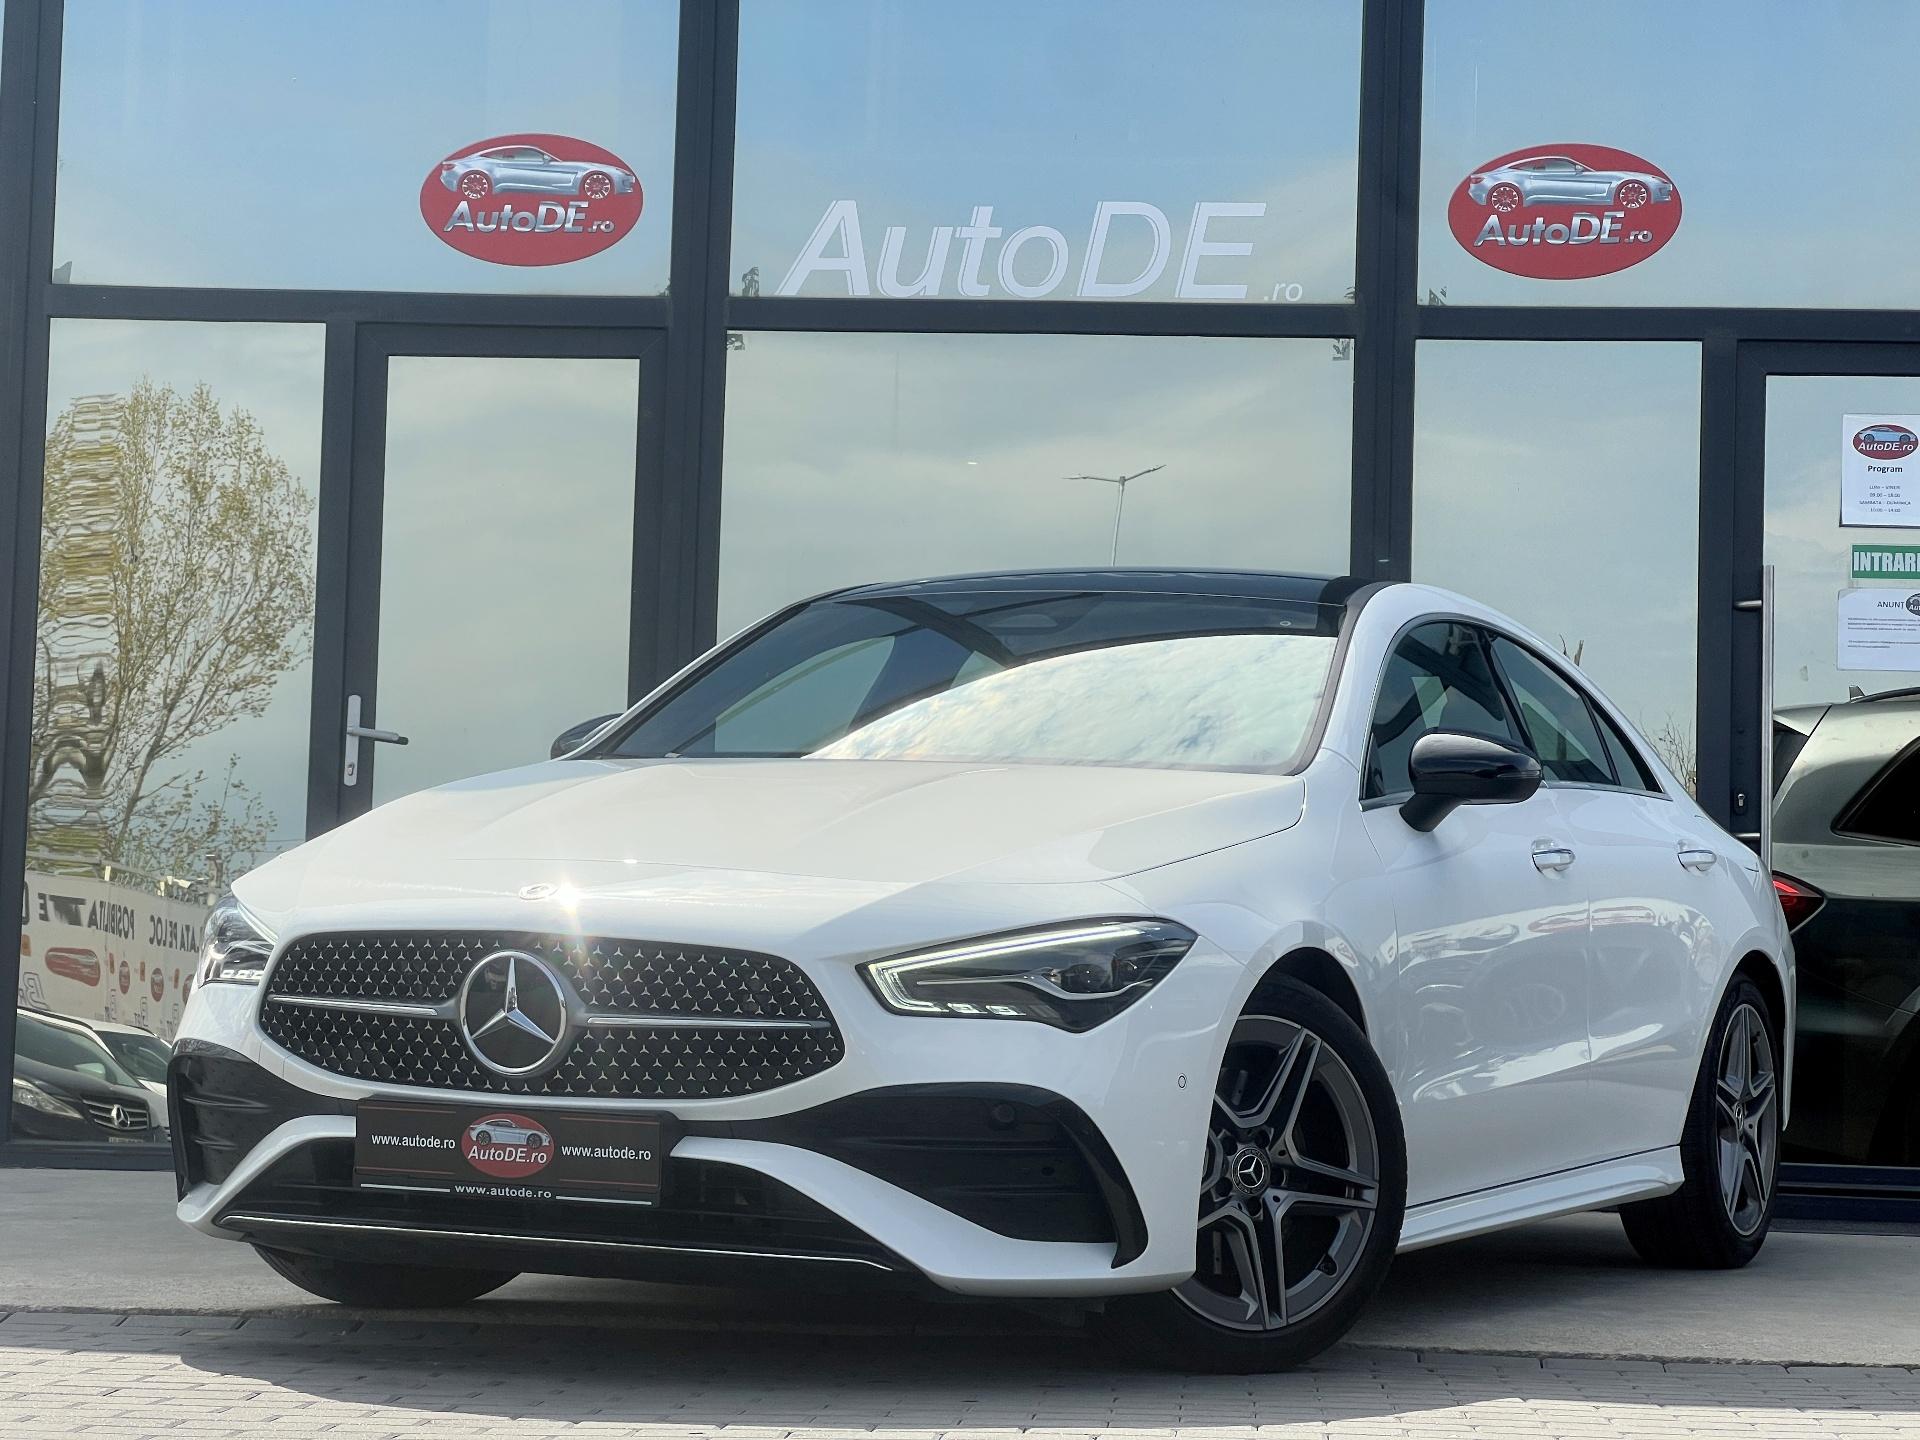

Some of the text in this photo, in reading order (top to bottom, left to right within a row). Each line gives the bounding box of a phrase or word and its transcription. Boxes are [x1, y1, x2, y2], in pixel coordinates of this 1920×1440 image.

[1858, 442, 1914, 451] AutoDE.ro
[1867, 465, 1903, 473] Program
[371, 1133, 456, 1149] www.autode.ro
[467, 1145, 547, 1164] AutoDE.ro
[561, 1145, 651, 1161] www.autode.ro
[455, 1184, 552, 1199] www.autode.ro
